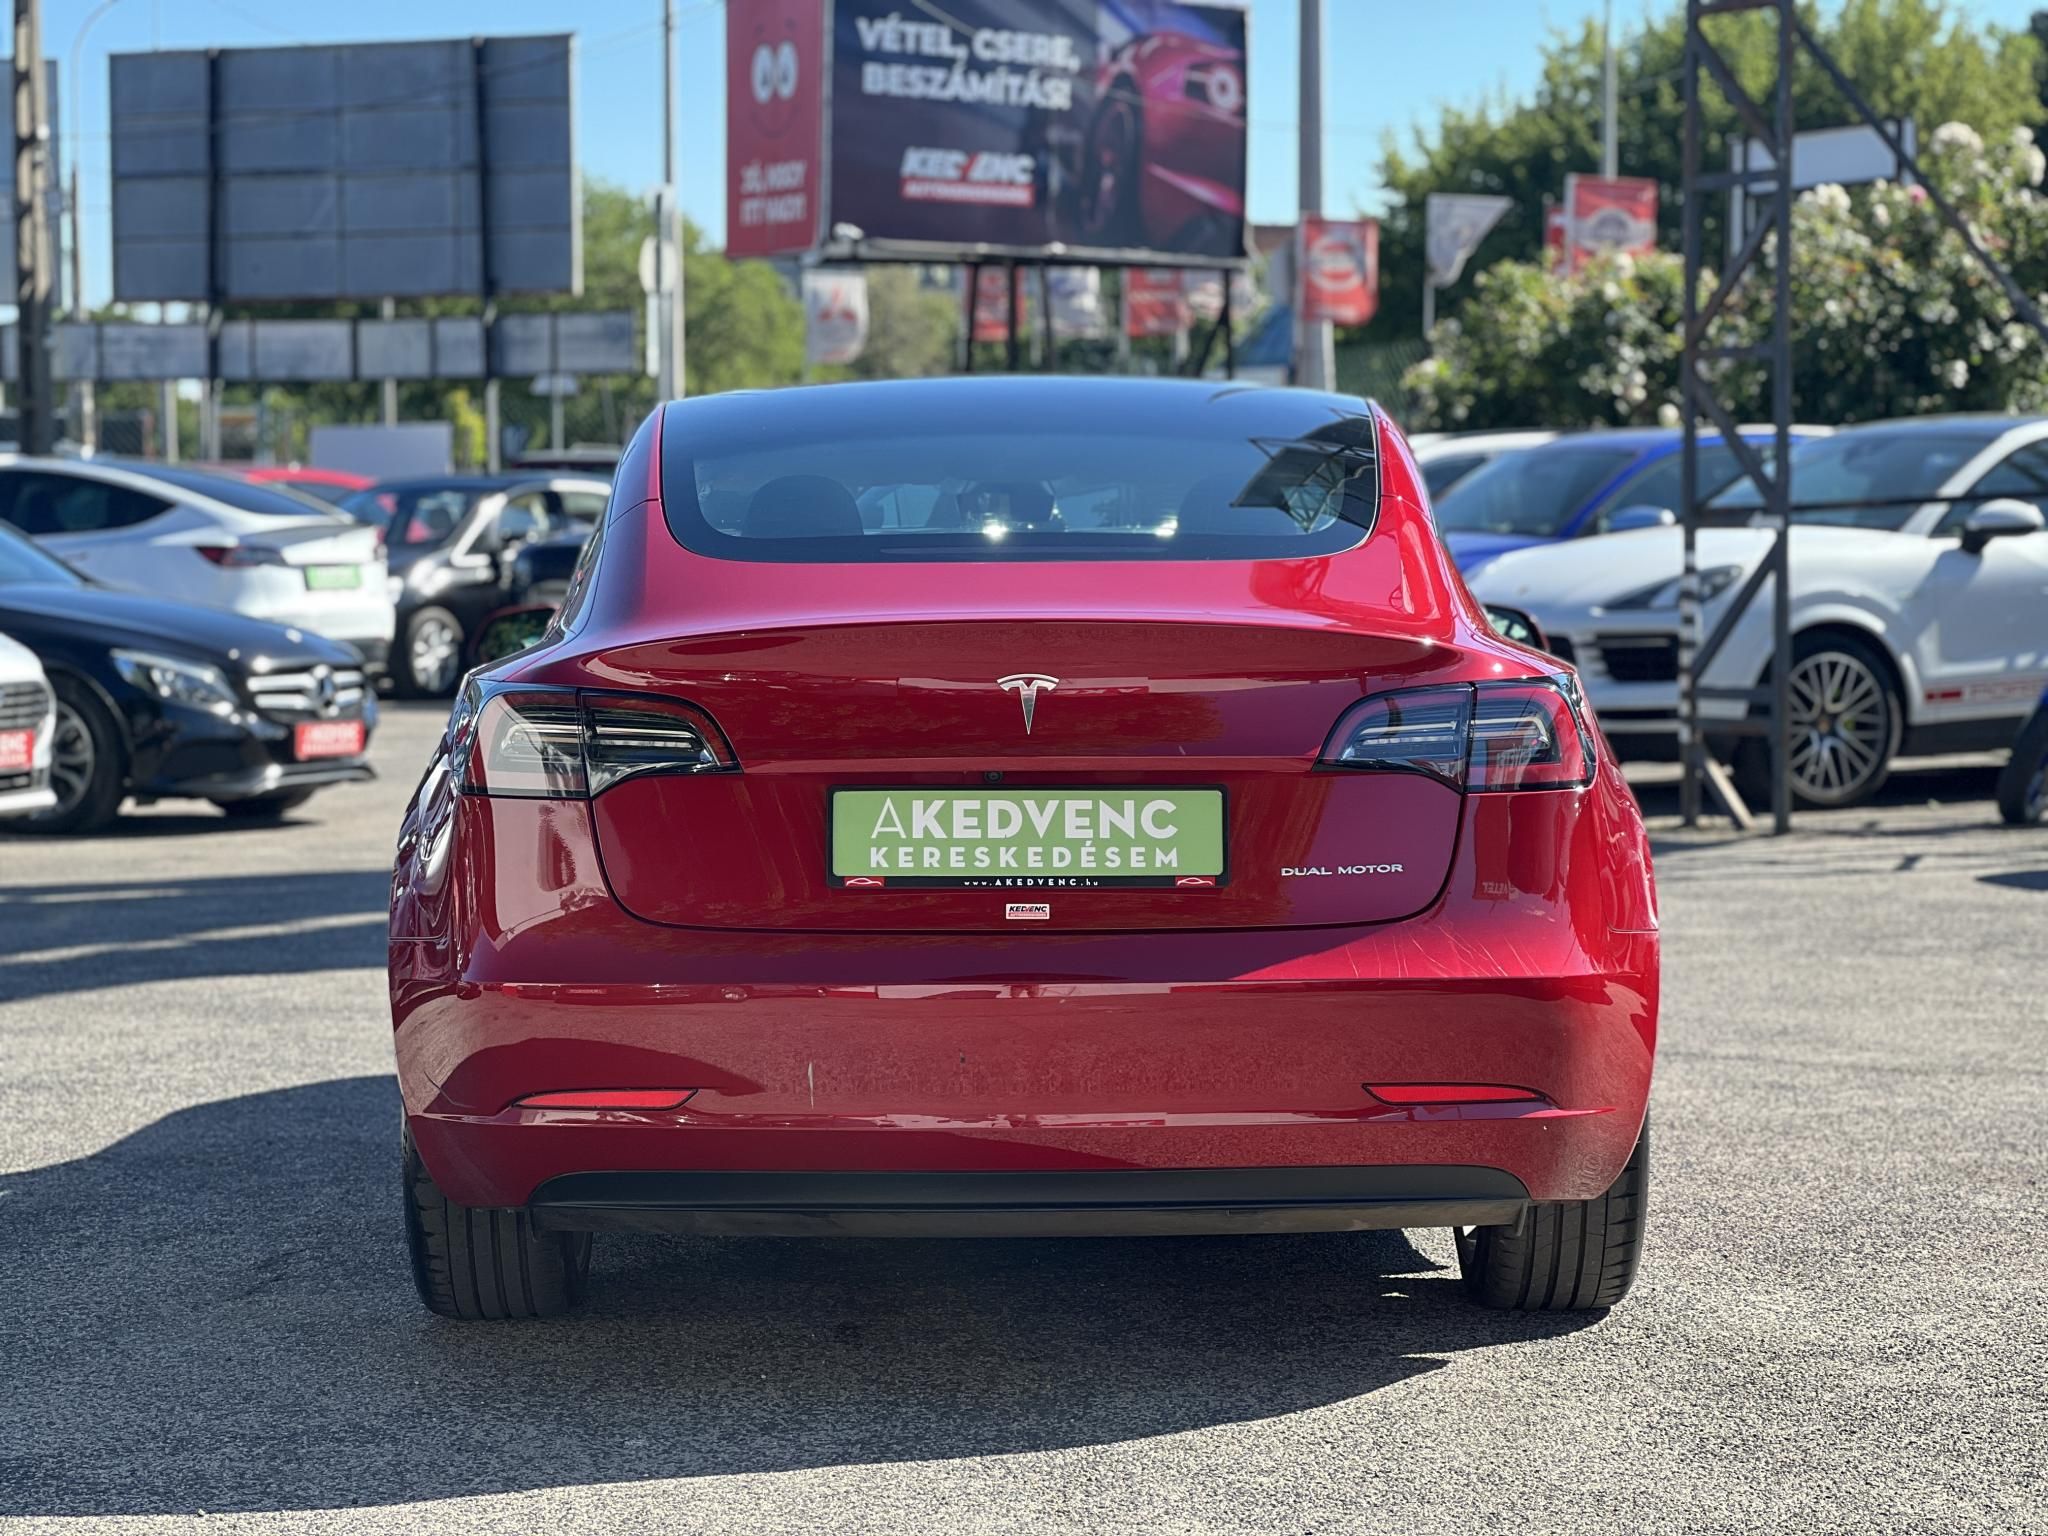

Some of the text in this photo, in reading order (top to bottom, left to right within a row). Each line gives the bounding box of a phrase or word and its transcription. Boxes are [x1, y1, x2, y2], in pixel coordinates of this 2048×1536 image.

[871, 797, 1178, 839] AKEDVENC
[871, 841, 1178, 868] KERESKEDÉSEM
[1281, 864, 1403, 876] DUAL MOTOR
[964, 878, 1099, 887] www.AKEDVENC.hu
